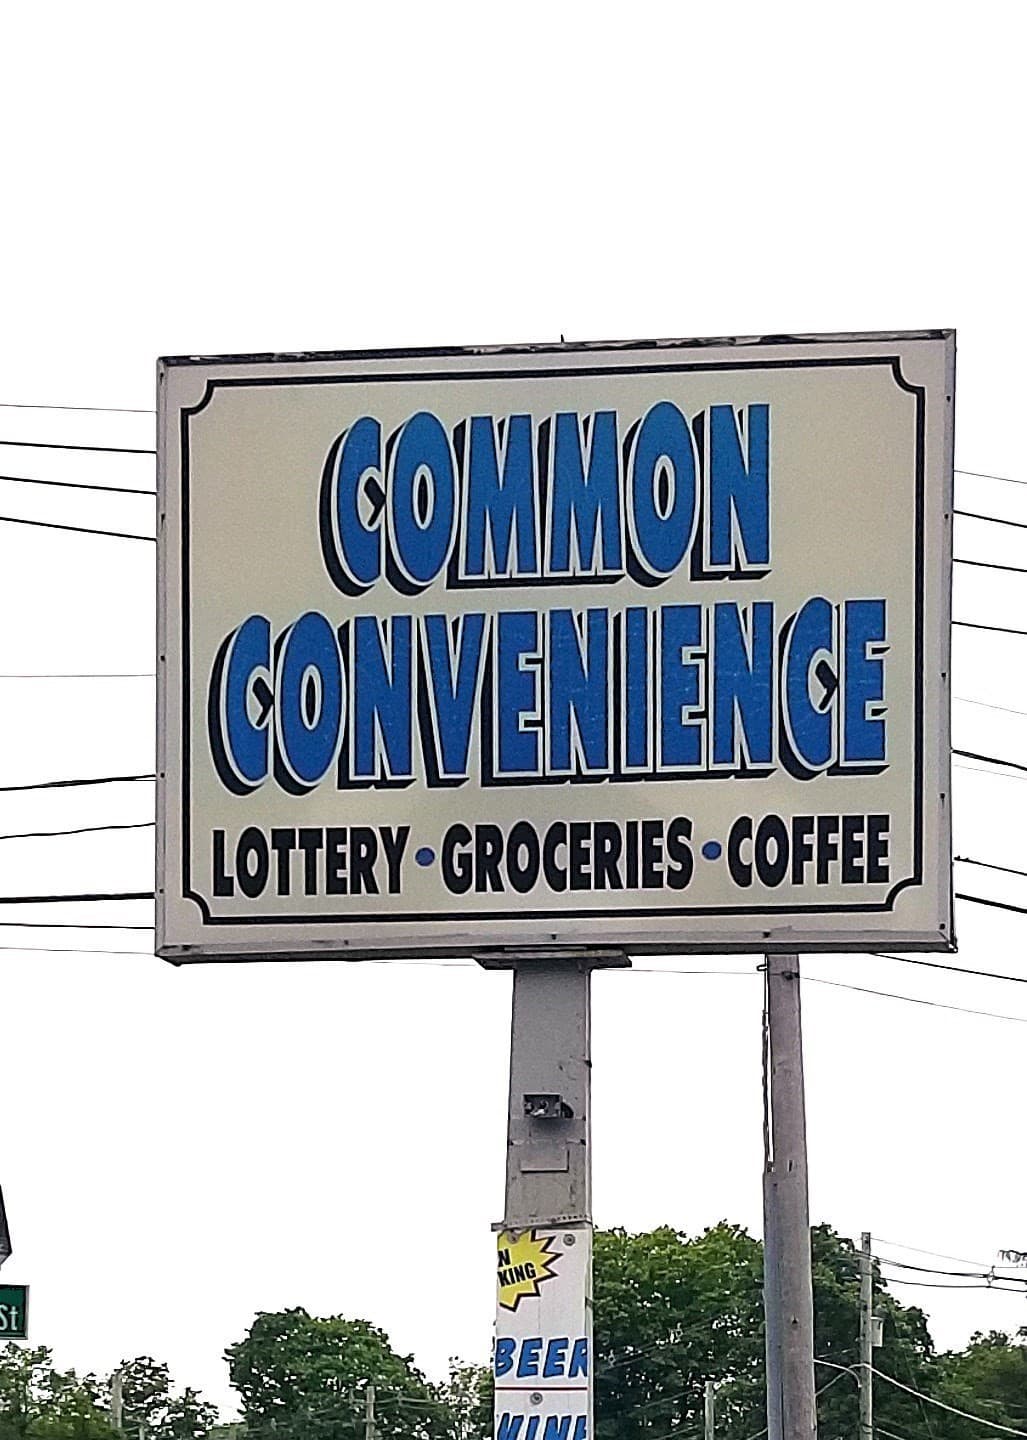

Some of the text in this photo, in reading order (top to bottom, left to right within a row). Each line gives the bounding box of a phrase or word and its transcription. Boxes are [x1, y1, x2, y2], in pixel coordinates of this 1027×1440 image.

[320, 401, 772, 596] COMMON
[208, 597, 891, 796] CONVENIENCE
[212, 815, 890, 898] LOTTERY GROCERIES COFFEE
[497, 1262, 537, 1287] KING
[0, 1304, 18, 1331] St
[495, 1337, 588, 1379] BEER
